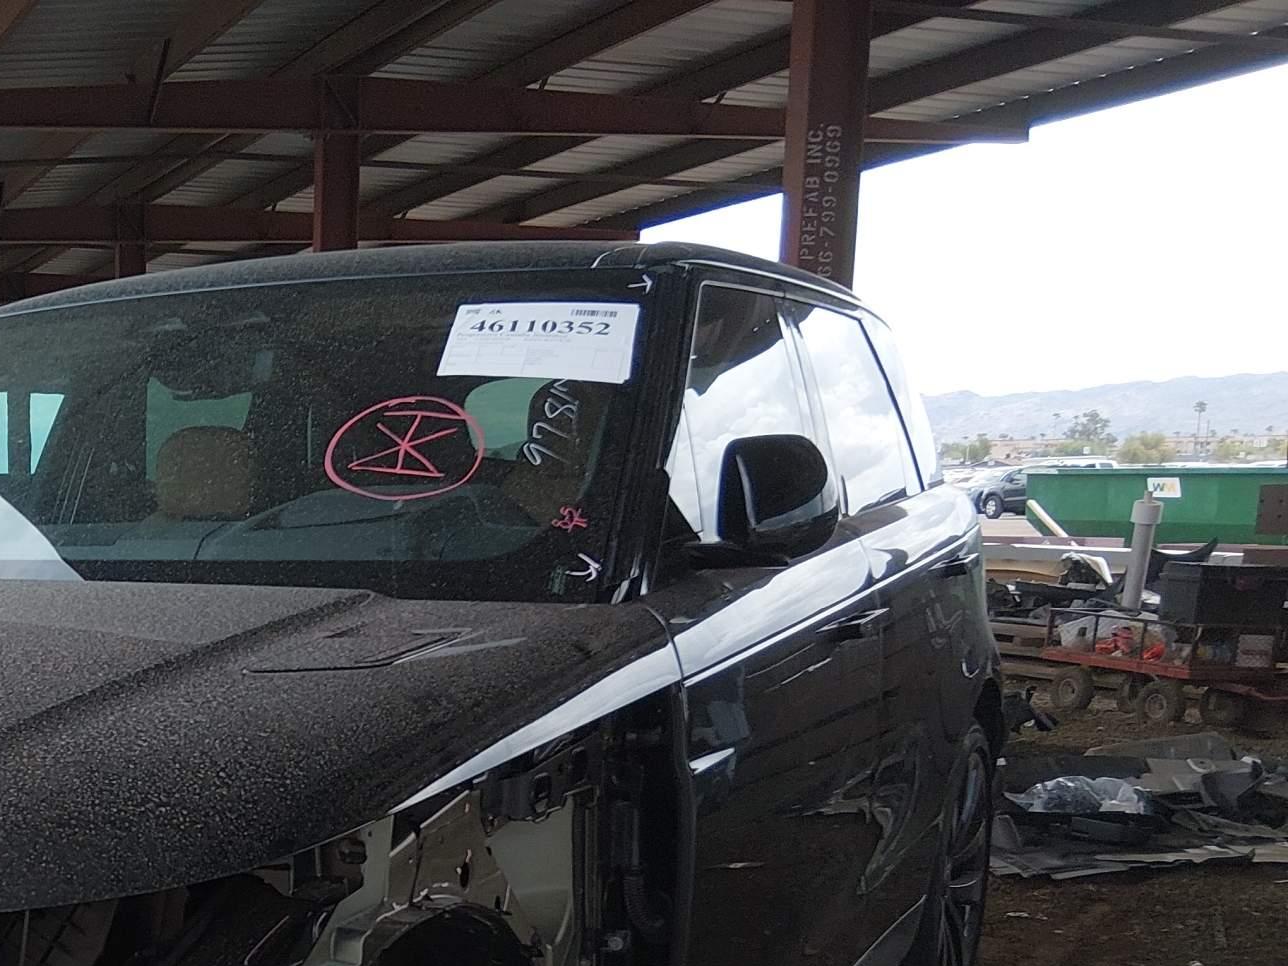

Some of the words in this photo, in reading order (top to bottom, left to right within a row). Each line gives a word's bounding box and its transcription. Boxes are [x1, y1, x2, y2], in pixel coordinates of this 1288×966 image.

[807, 123, 825, 164] INC.
[800, 177, 820, 259] PREFAB
[469, 319, 612, 336] 46110352
